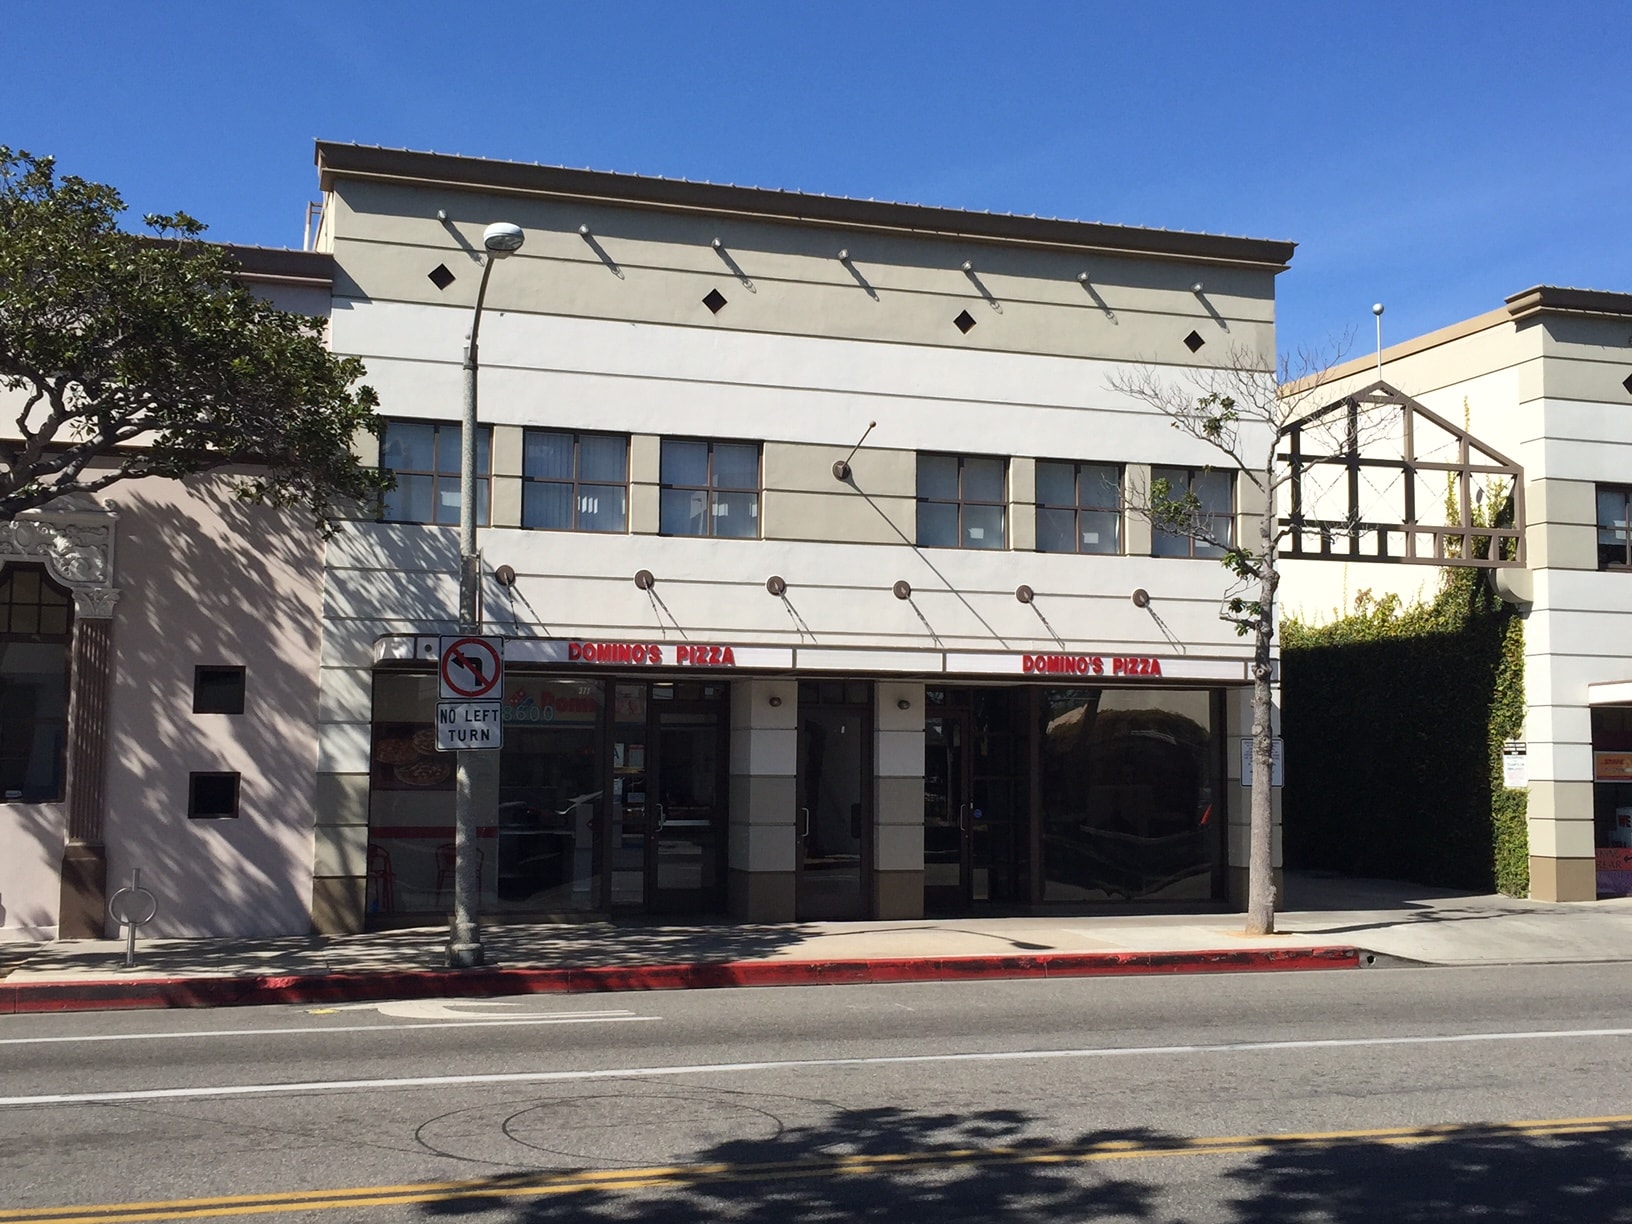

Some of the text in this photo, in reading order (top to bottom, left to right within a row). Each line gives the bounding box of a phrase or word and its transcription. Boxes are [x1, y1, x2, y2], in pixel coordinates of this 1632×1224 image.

[568, 642, 736, 666] DOMINO'S PIZZA
[1022, 654, 1162, 677] DOMINO'S PIZZA
[440, 709, 499, 724] NO LEFT
[448, 729, 490, 742] TURN
